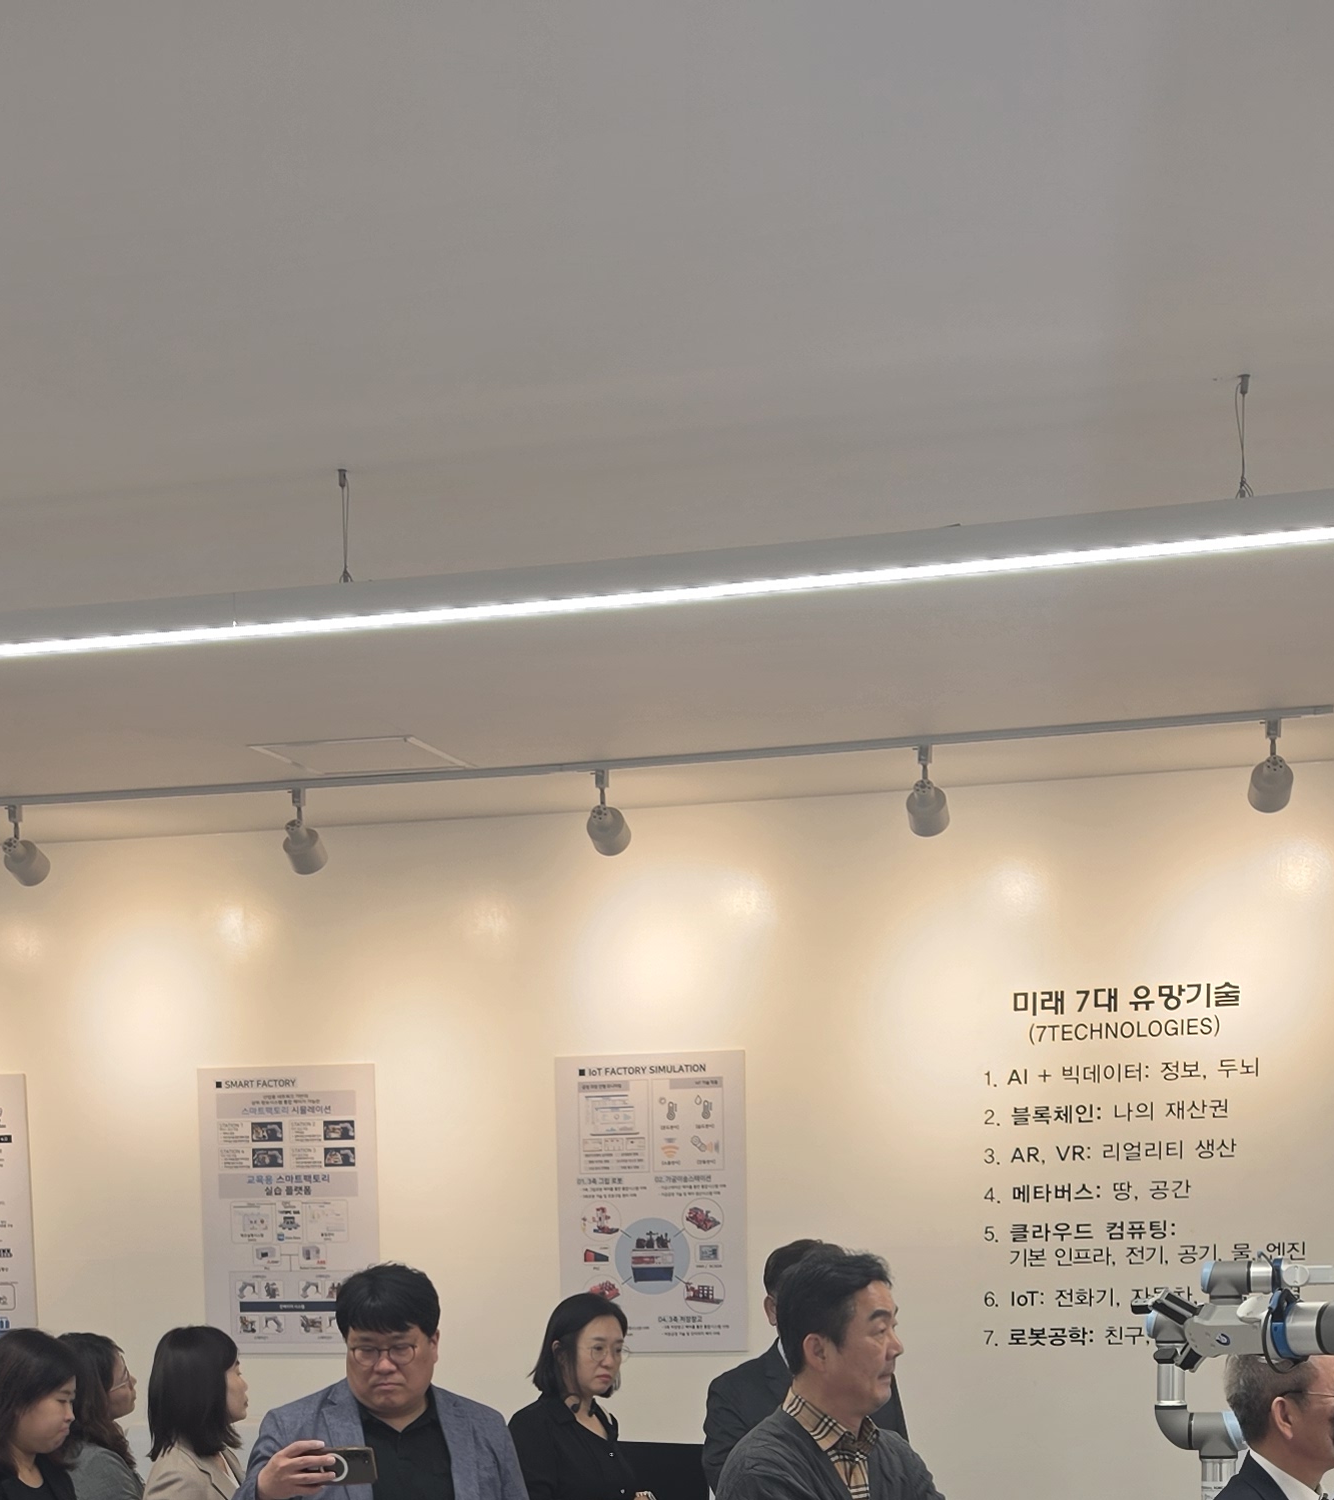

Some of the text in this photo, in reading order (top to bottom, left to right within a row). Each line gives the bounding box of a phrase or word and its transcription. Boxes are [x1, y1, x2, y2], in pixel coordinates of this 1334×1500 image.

[1013, 981, 1241, 1016] 미래 7대 유망기술
[1029, 1014, 1220, 1045] (7TECHNOLOGIES)
[588, 1064, 707, 1077] IoT FACTORY SIMULATION
[984, 1070, 998, 1087] 1.
[1008, 1068, 1029, 1086] AI
[1062, 1062, 1150, 1085] 빅데이터:
[1160, 1060, 1207, 1081] 정보,
[1217, 1057, 1261, 1078] 두뇌
[225, 1079, 296, 1089] SMART FACTORY
[242, 1105, 332, 1116] 스마트팩토리 시뮬레이션
[984, 1098, 1229, 1127] 2. 블록체인: 나의 재산권
[984, 1139, 1237, 1166] 3. AR, VR: 리얼리티 생산
[276, 1174, 330, 1184] 스마트팩토리
[264, 1186, 312, 1196] 실습 플랫폼
[984, 1179, 1192, 1204] 4. 메타버스: 땅, 공간
[984, 1219, 1176, 1243] 5. 클라우드 컴퓨팅:
[1010, 1248, 1047, 1267] 기본
[1055, 1247, 1116, 1267] 인프라,
[1126, 1246, 1169, 1265] 전기,
[1178, 1244, 1222, 1262] 공기,
[984, 1291, 999, 1308] 6.
[1011, 1290, 1045, 1307] IoT:
[1055, 1288, 1120, 1308] 전화기,
[983, 1330, 998, 1346] 7.
[1008, 1327, 1094, 1346] 로봇공학:
